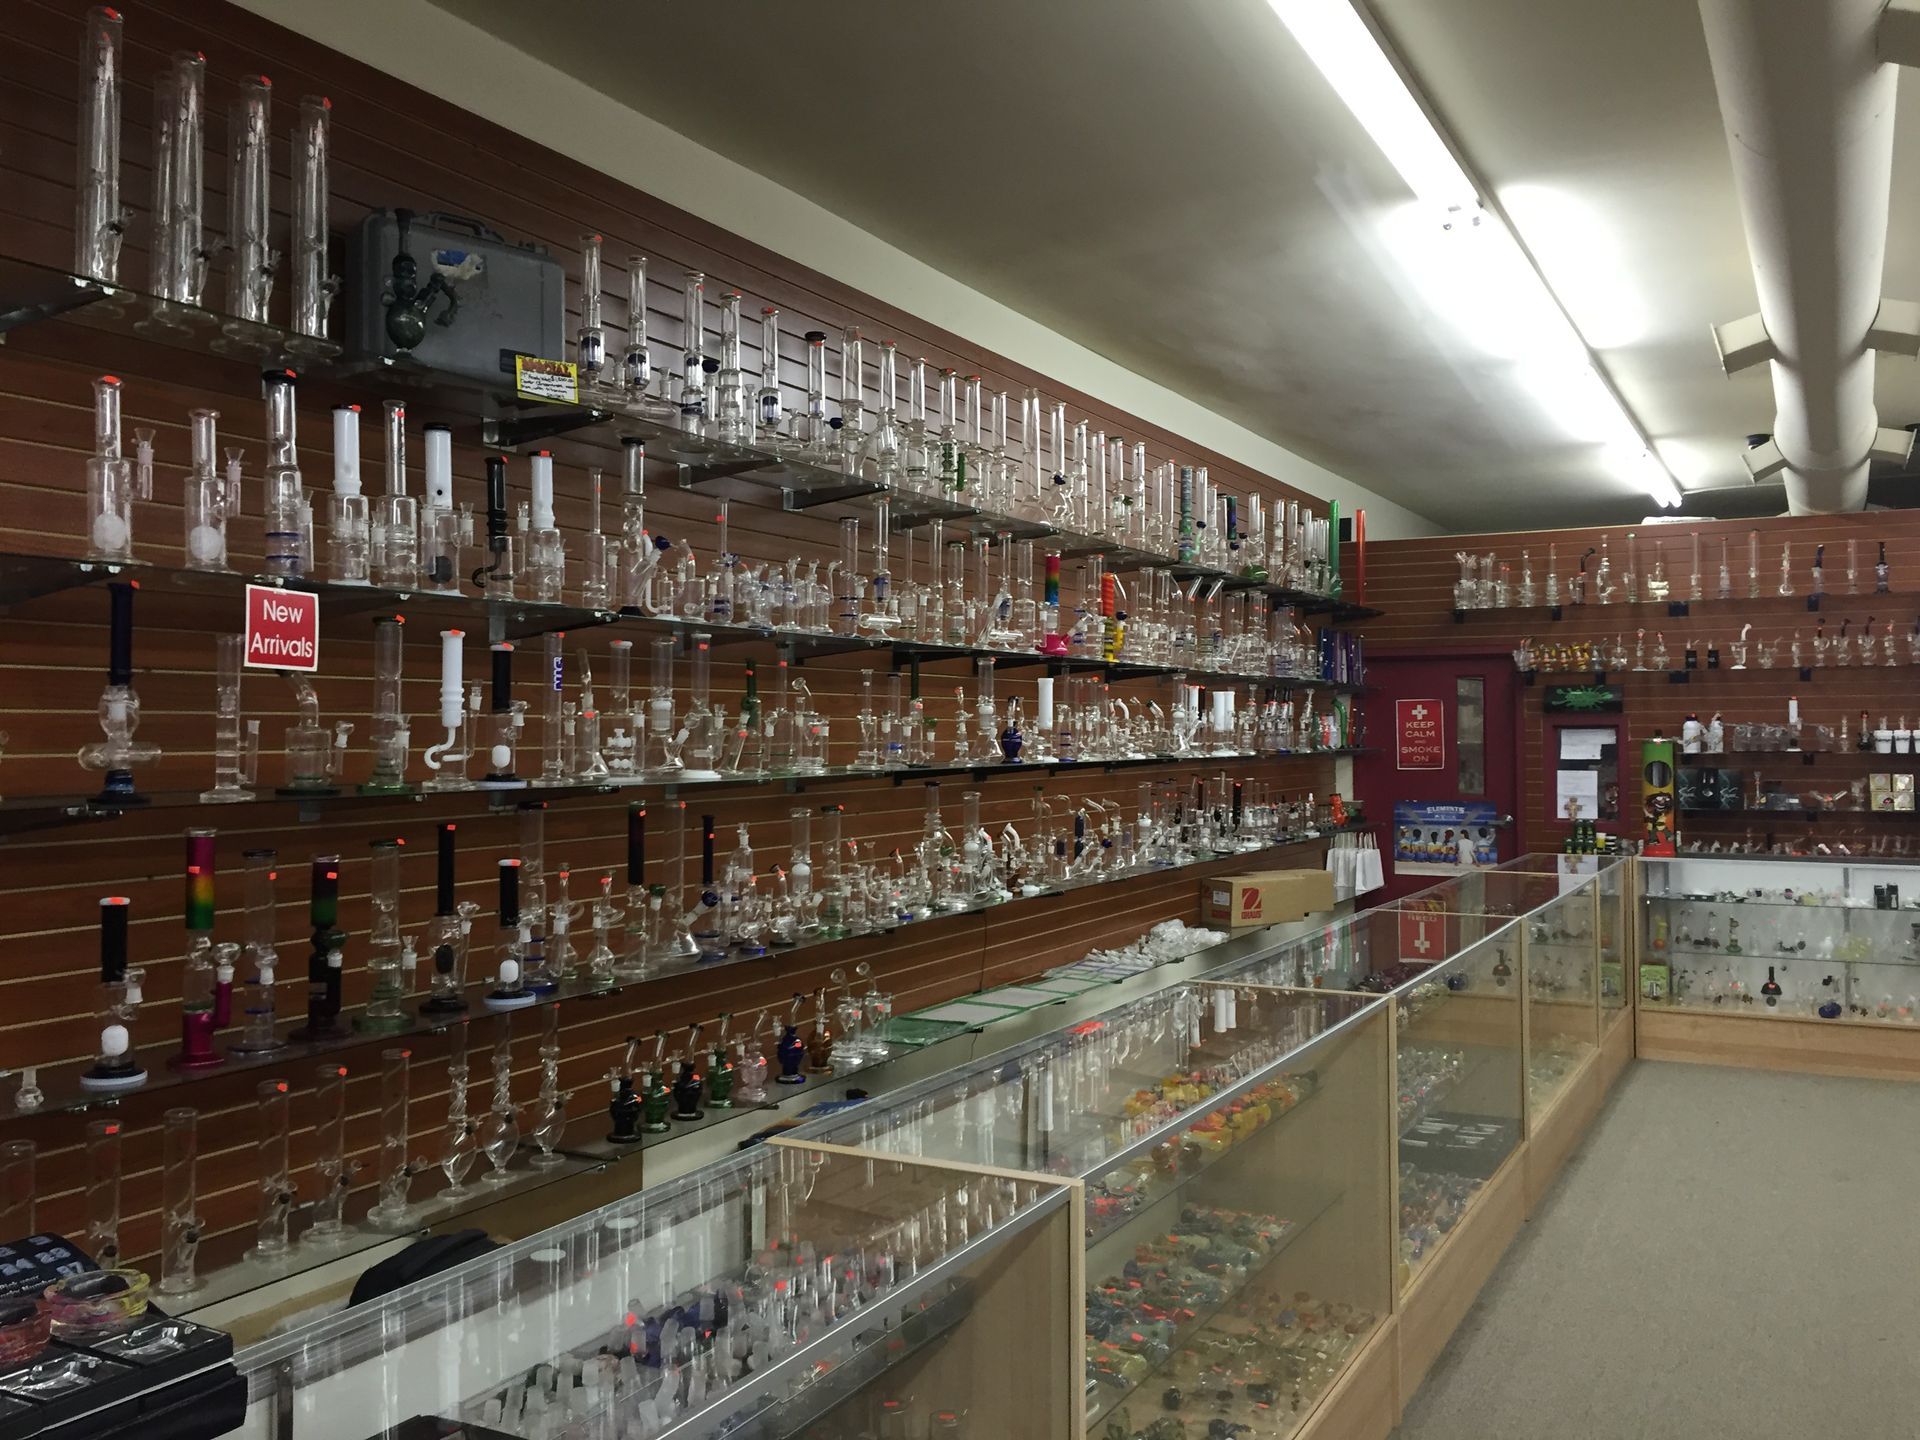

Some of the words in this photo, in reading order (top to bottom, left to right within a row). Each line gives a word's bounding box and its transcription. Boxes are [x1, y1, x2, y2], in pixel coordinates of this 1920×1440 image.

[263, 599, 303, 624] New
[250, 632, 313, 658] Arrivals
[1405, 730, 1435, 738] CALM
[1426, 805, 1465, 814] ELEMENTS
